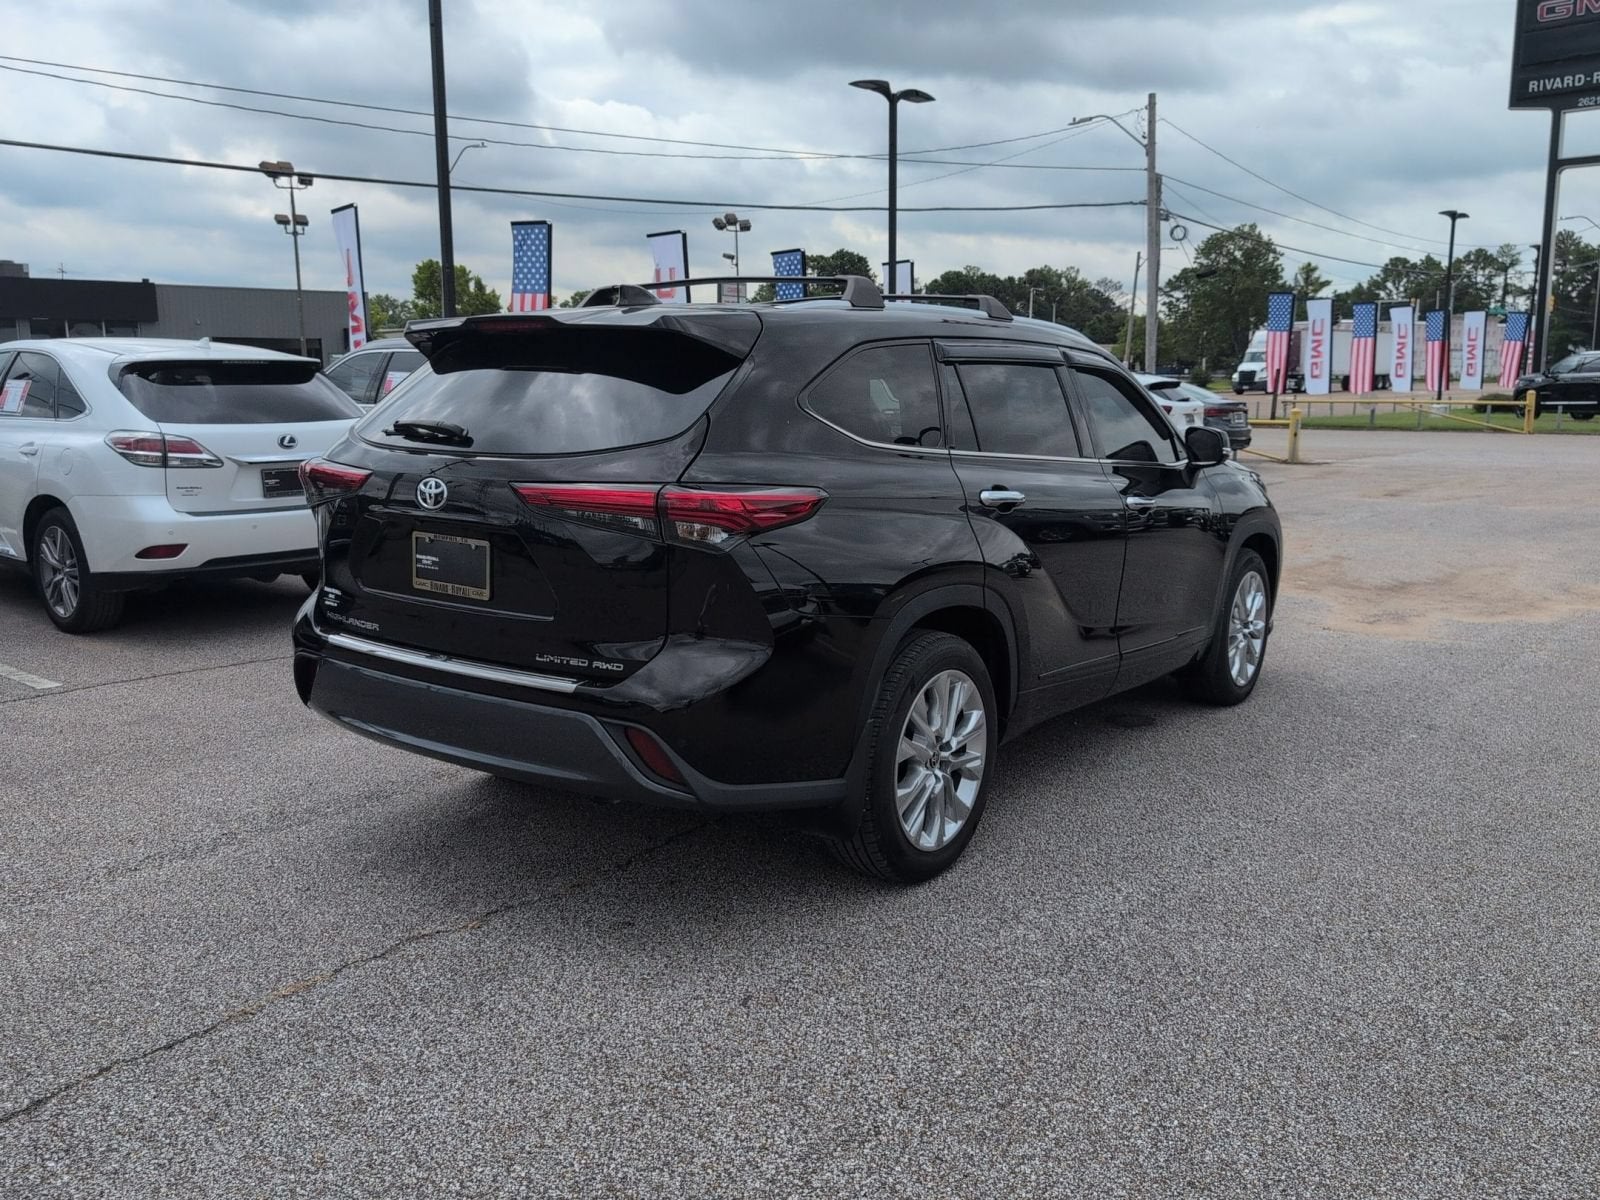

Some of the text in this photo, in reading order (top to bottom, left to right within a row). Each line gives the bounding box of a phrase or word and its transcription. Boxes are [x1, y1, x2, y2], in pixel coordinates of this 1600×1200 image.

[1310, 319, 1325, 379] GMC
[1394, 323, 1408, 379] GMC
[1466, 327, 1479, 378] GMC
[326, 611, 380, 631] HIGHLANDER
[535, 653, 624, 671] LIMITED AWD
